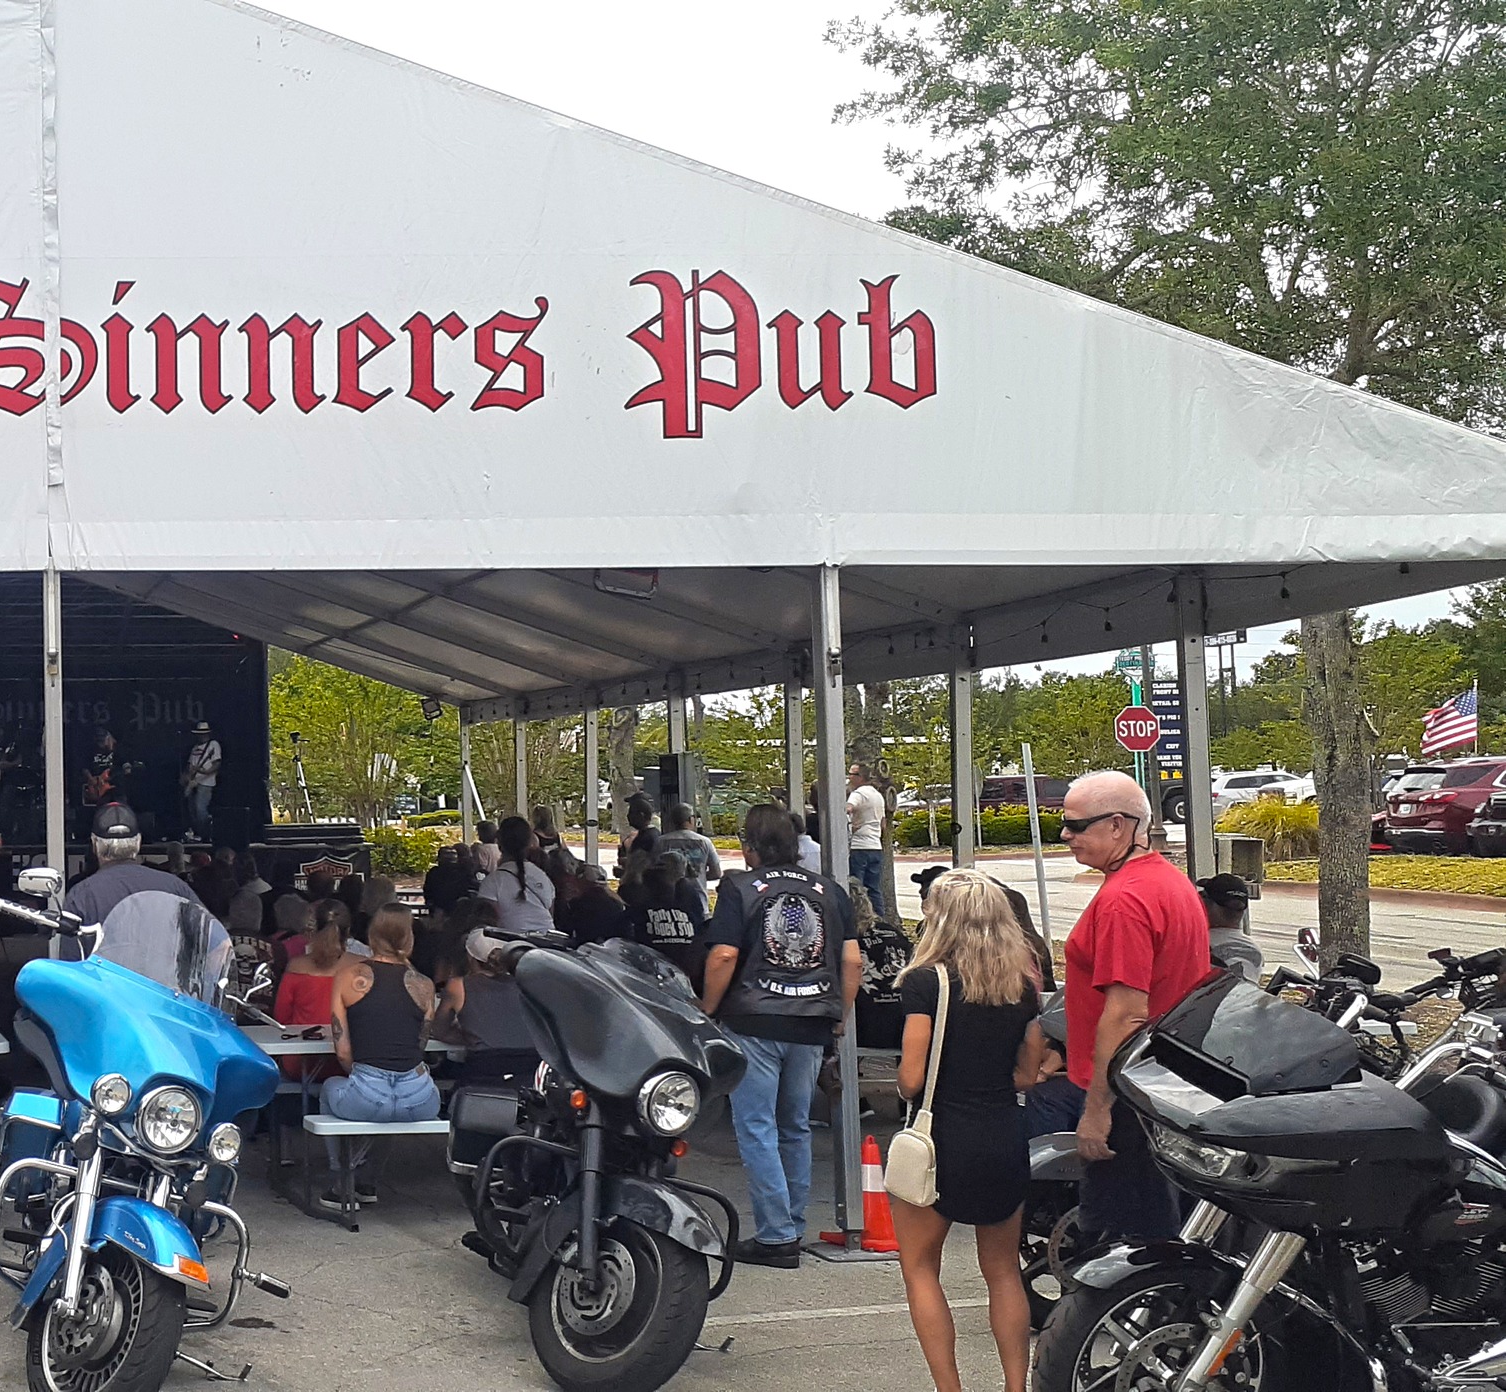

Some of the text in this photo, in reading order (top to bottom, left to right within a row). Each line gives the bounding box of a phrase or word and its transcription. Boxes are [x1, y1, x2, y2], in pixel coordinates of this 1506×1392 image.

[624, 269, 937, 439] Pub
[1119, 721, 1156, 737] STOP
[765, 870, 808, 881] AIR FORCE
[783, 985, 796, 996] AIR
[797, 984, 821, 996] FORCE
